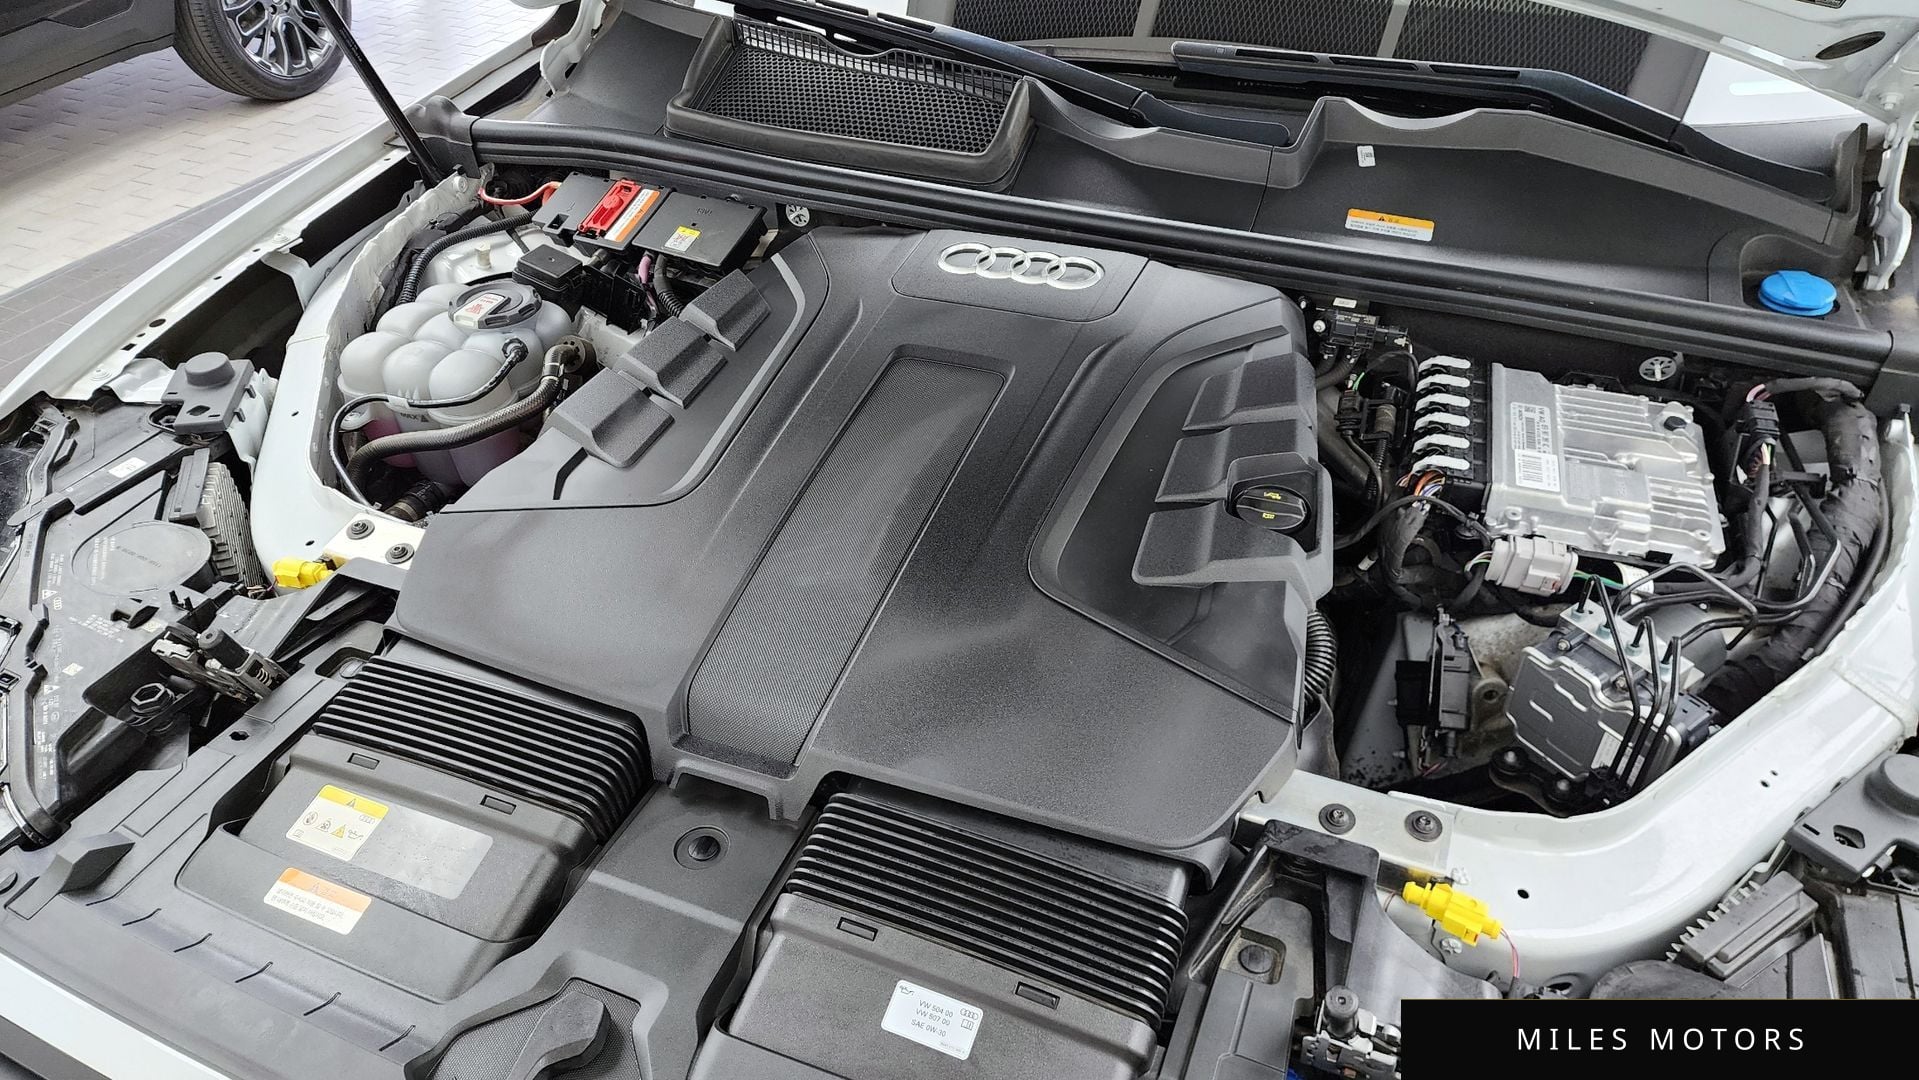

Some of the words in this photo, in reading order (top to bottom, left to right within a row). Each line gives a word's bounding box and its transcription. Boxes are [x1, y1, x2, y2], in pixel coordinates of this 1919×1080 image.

[916, 1008, 928, 1017] VW
[929, 1013, 941, 1022] 507
[942, 1018, 950, 1026] 00
[919, 999, 932, 1009] VW
[932, 1005, 944, 1014] 504
[945, 1010, 954, 1018] 00
[911, 1019, 925, 1029] SAE
[926, 1025, 946, 1037] 0W-30
